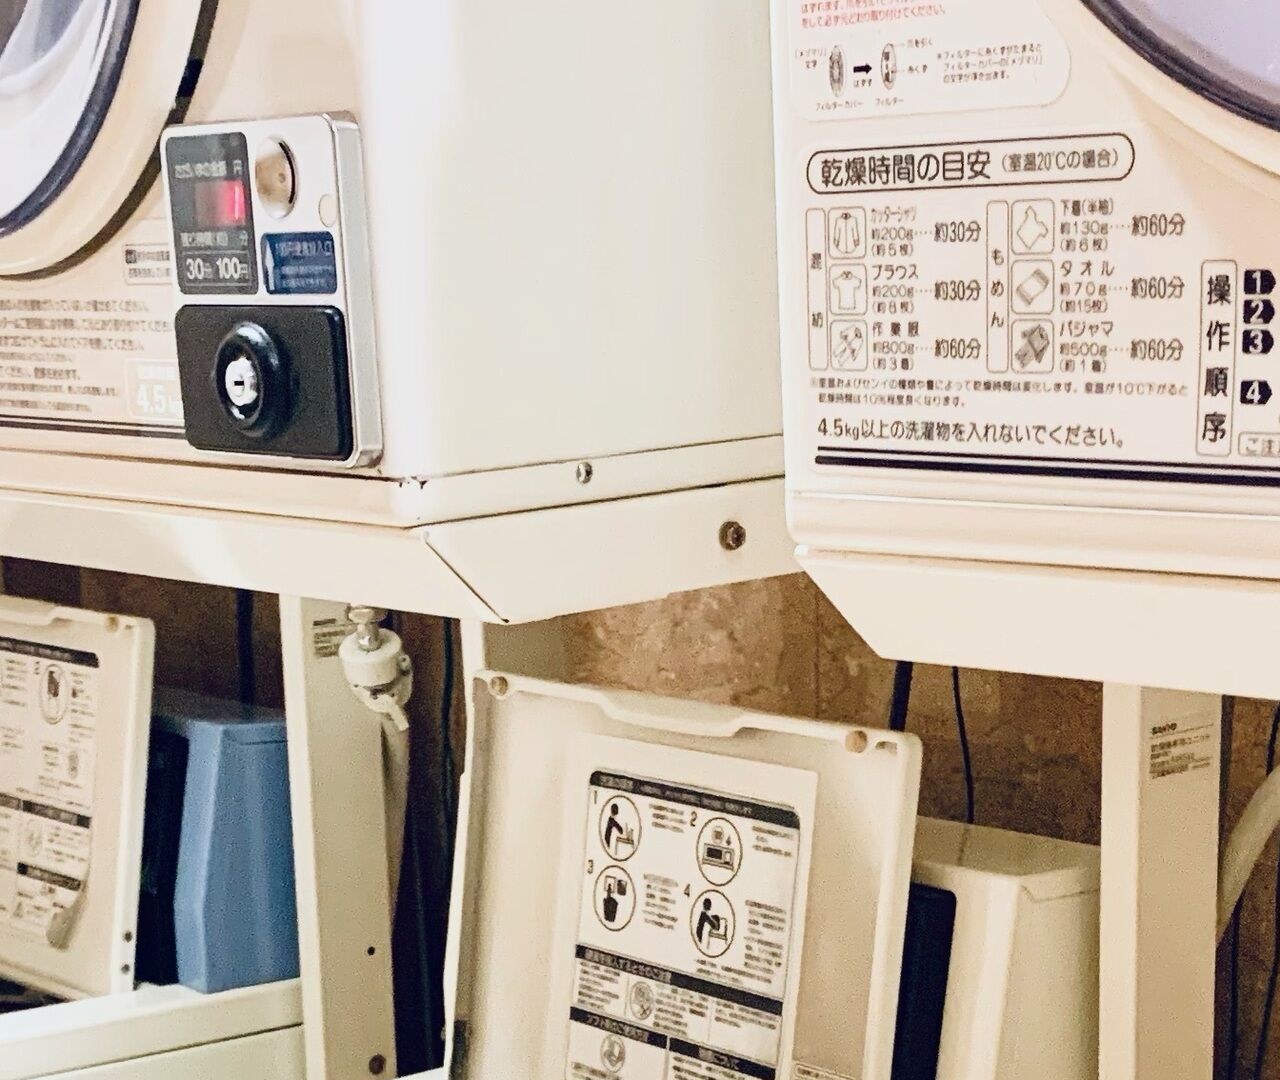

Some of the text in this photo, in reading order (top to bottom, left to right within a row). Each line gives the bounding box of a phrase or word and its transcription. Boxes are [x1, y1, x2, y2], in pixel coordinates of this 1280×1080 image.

[821, 150, 992, 188] 乾燥時間の目安
[934, 220, 982, 243] 約30分
[1131, 213, 1186, 237] 約60分
[872, 263, 919, 281] ブラウス
[934, 279, 982, 301] 約30分
[1131, 275, 1186, 299] 約60分
[1060, 320, 1114, 337] パジャマ
[935, 337, 982, 359] 約60分
[1130, 337, 1185, 361] 約60分
[1201, 273, 1232, 444] 操作順序
[817, 418, 1124, 449] 4.5kg以上の洗濯物を入れないでください。
